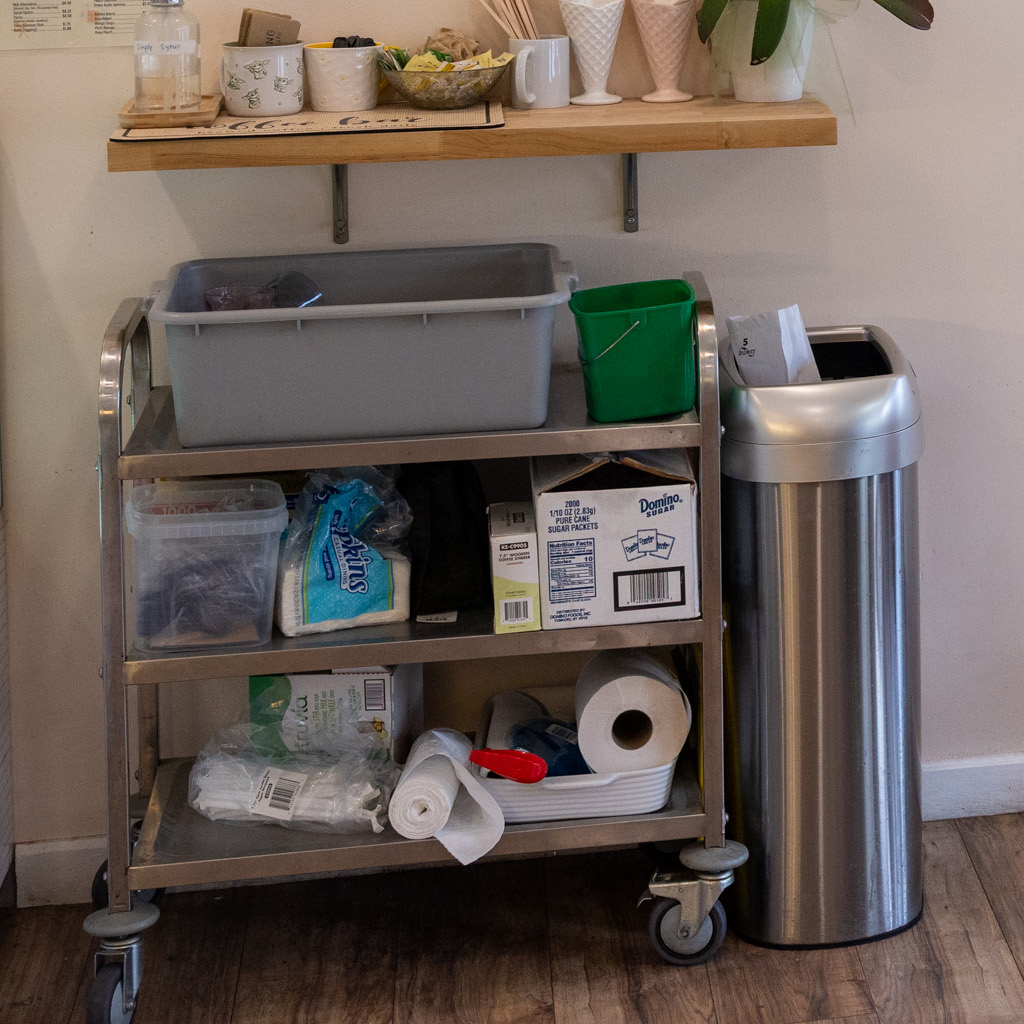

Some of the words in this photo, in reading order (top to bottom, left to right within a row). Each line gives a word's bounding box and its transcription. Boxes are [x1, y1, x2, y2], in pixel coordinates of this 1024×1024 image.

[743, 338, 748, 346] 5
[738, 348, 756, 356] DURO
[564, 500, 580, 508] 2000
[638, 493, 679, 514] Domino
[550, 509, 563, 517] 1/10
[564, 508, 573, 516] OZ
[573, 507, 596, 516] (2.83g)
[646, 504, 675, 518] SUGAR
[573, 515, 590, 523] CANE
[548, 525, 570, 533] SUGAR
[571, 522, 599, 532] PACKETS
[334, 538, 344, 563] CASUAL
